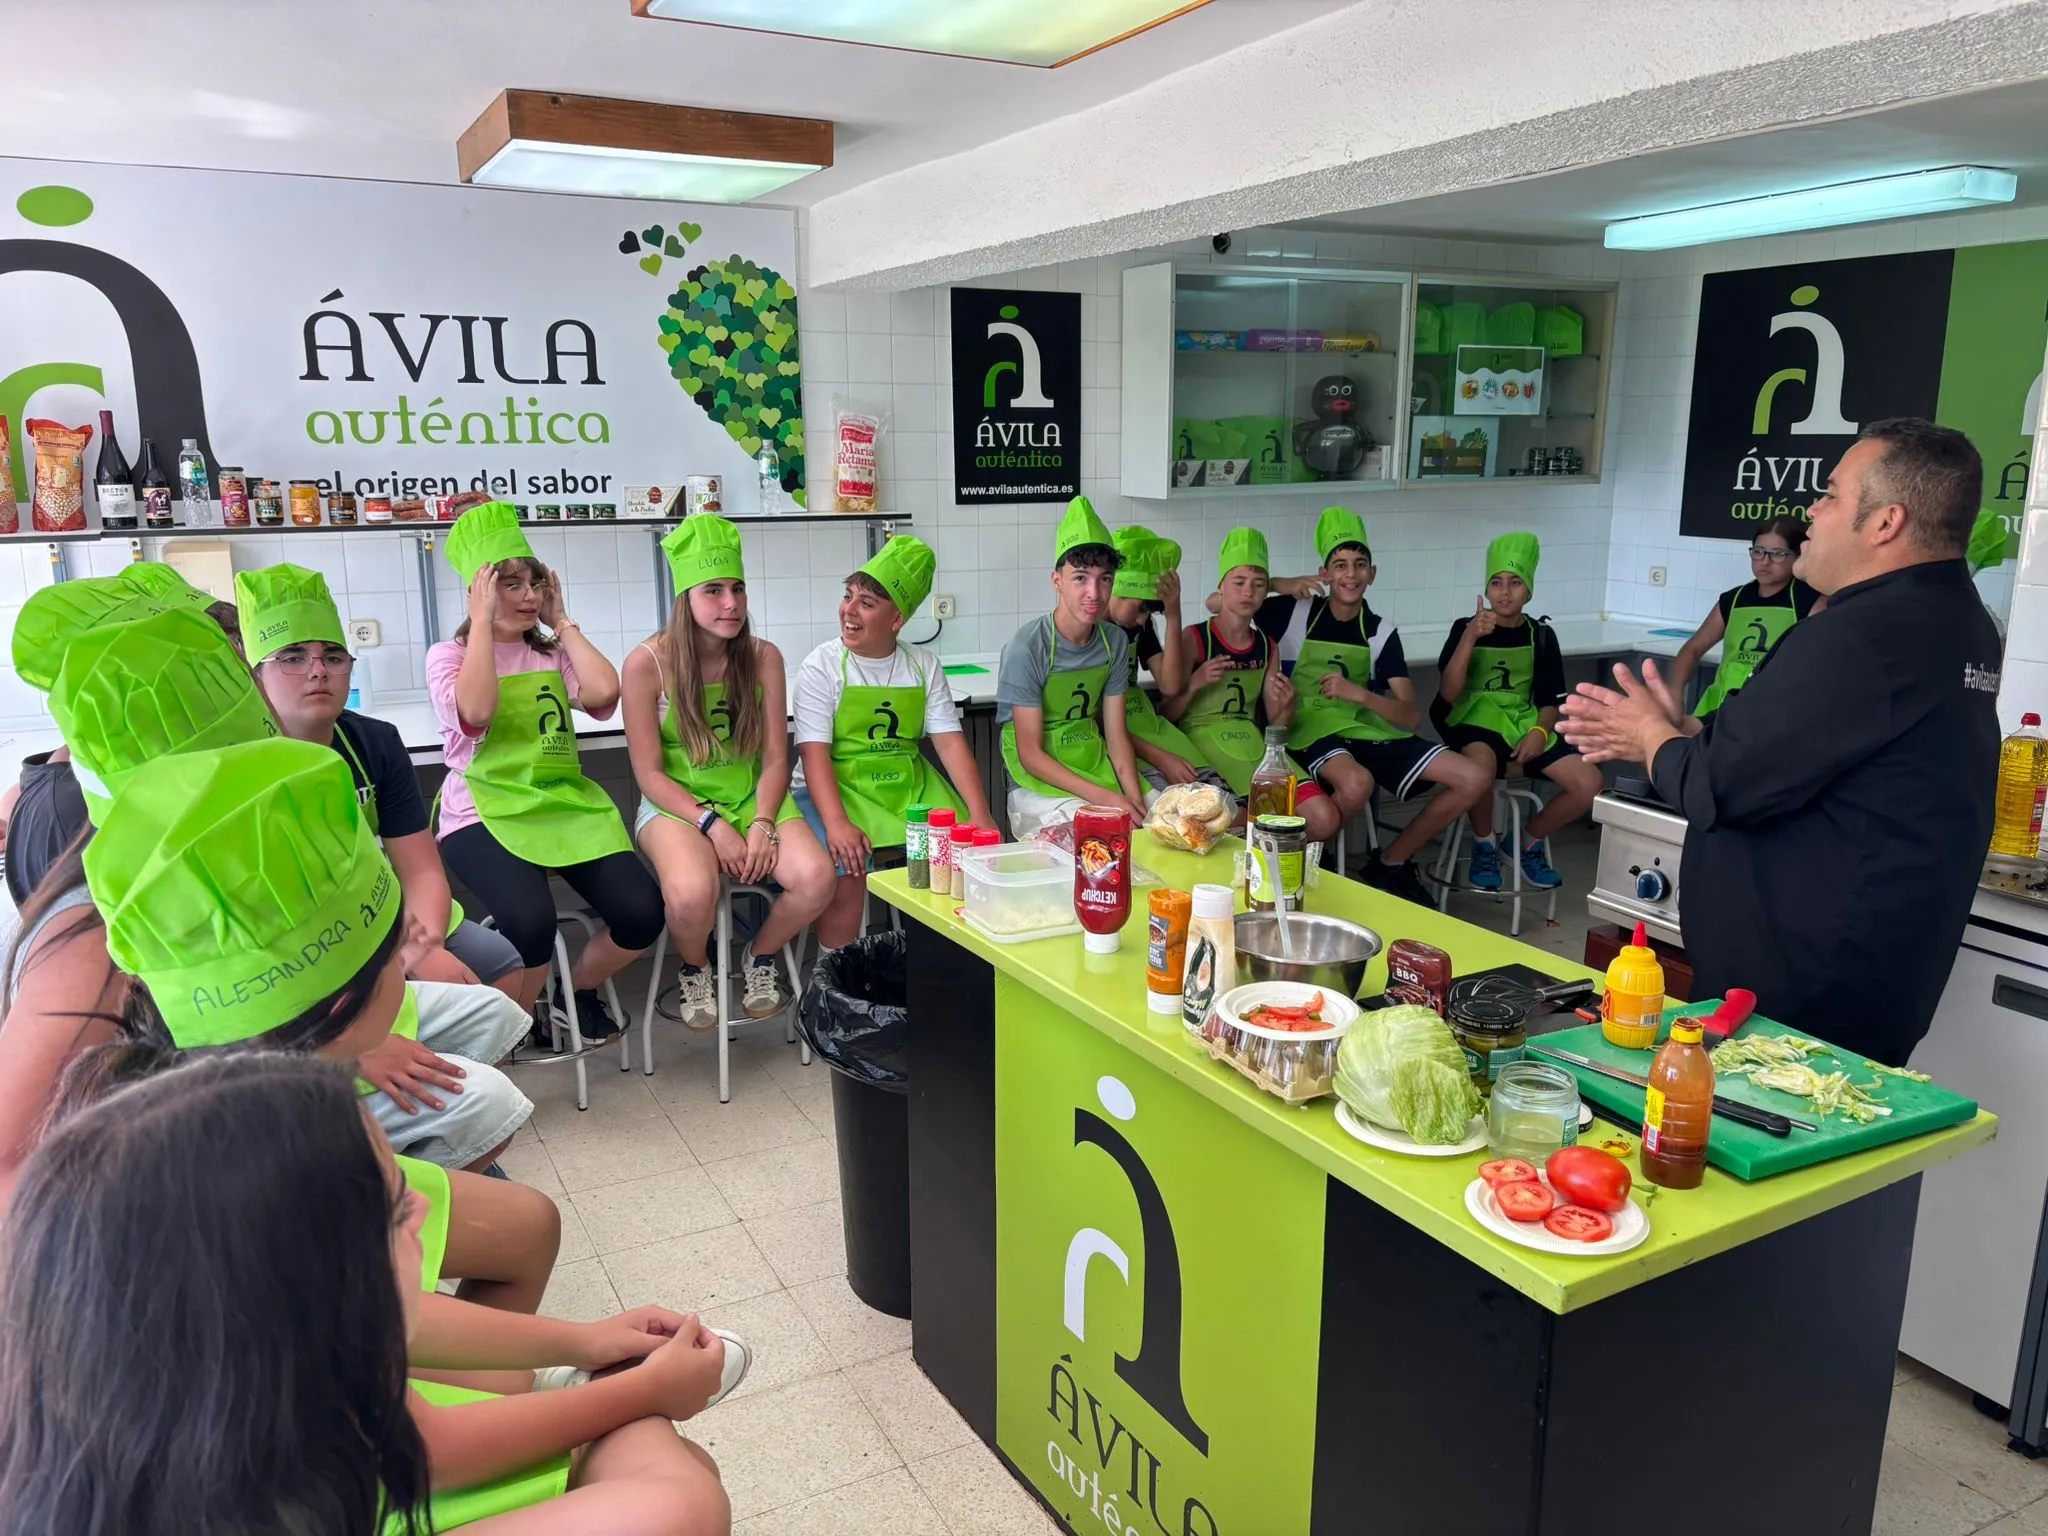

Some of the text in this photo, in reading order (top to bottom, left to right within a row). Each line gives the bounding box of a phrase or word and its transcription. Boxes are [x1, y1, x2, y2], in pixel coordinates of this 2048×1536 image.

[299, 288, 606, 385] ÁVILA
[305, 395, 610, 444] auténtica
[975, 416, 1062, 447] ÁVILA
[975, 449, 1063, 468] auténtica
[1732, 446, 1830, 493] ÁVIL
[315, 468, 612, 500] el origen del sabor
[960, 483, 1074, 495] www.avilaautentica.es
[1731, 496, 1818, 523] autén
[1081, 887, 1117, 905] KETCHUP
[192, 919, 353, 1016] ALEJANDRA
[1396, 967, 1418, 985] BBQ
